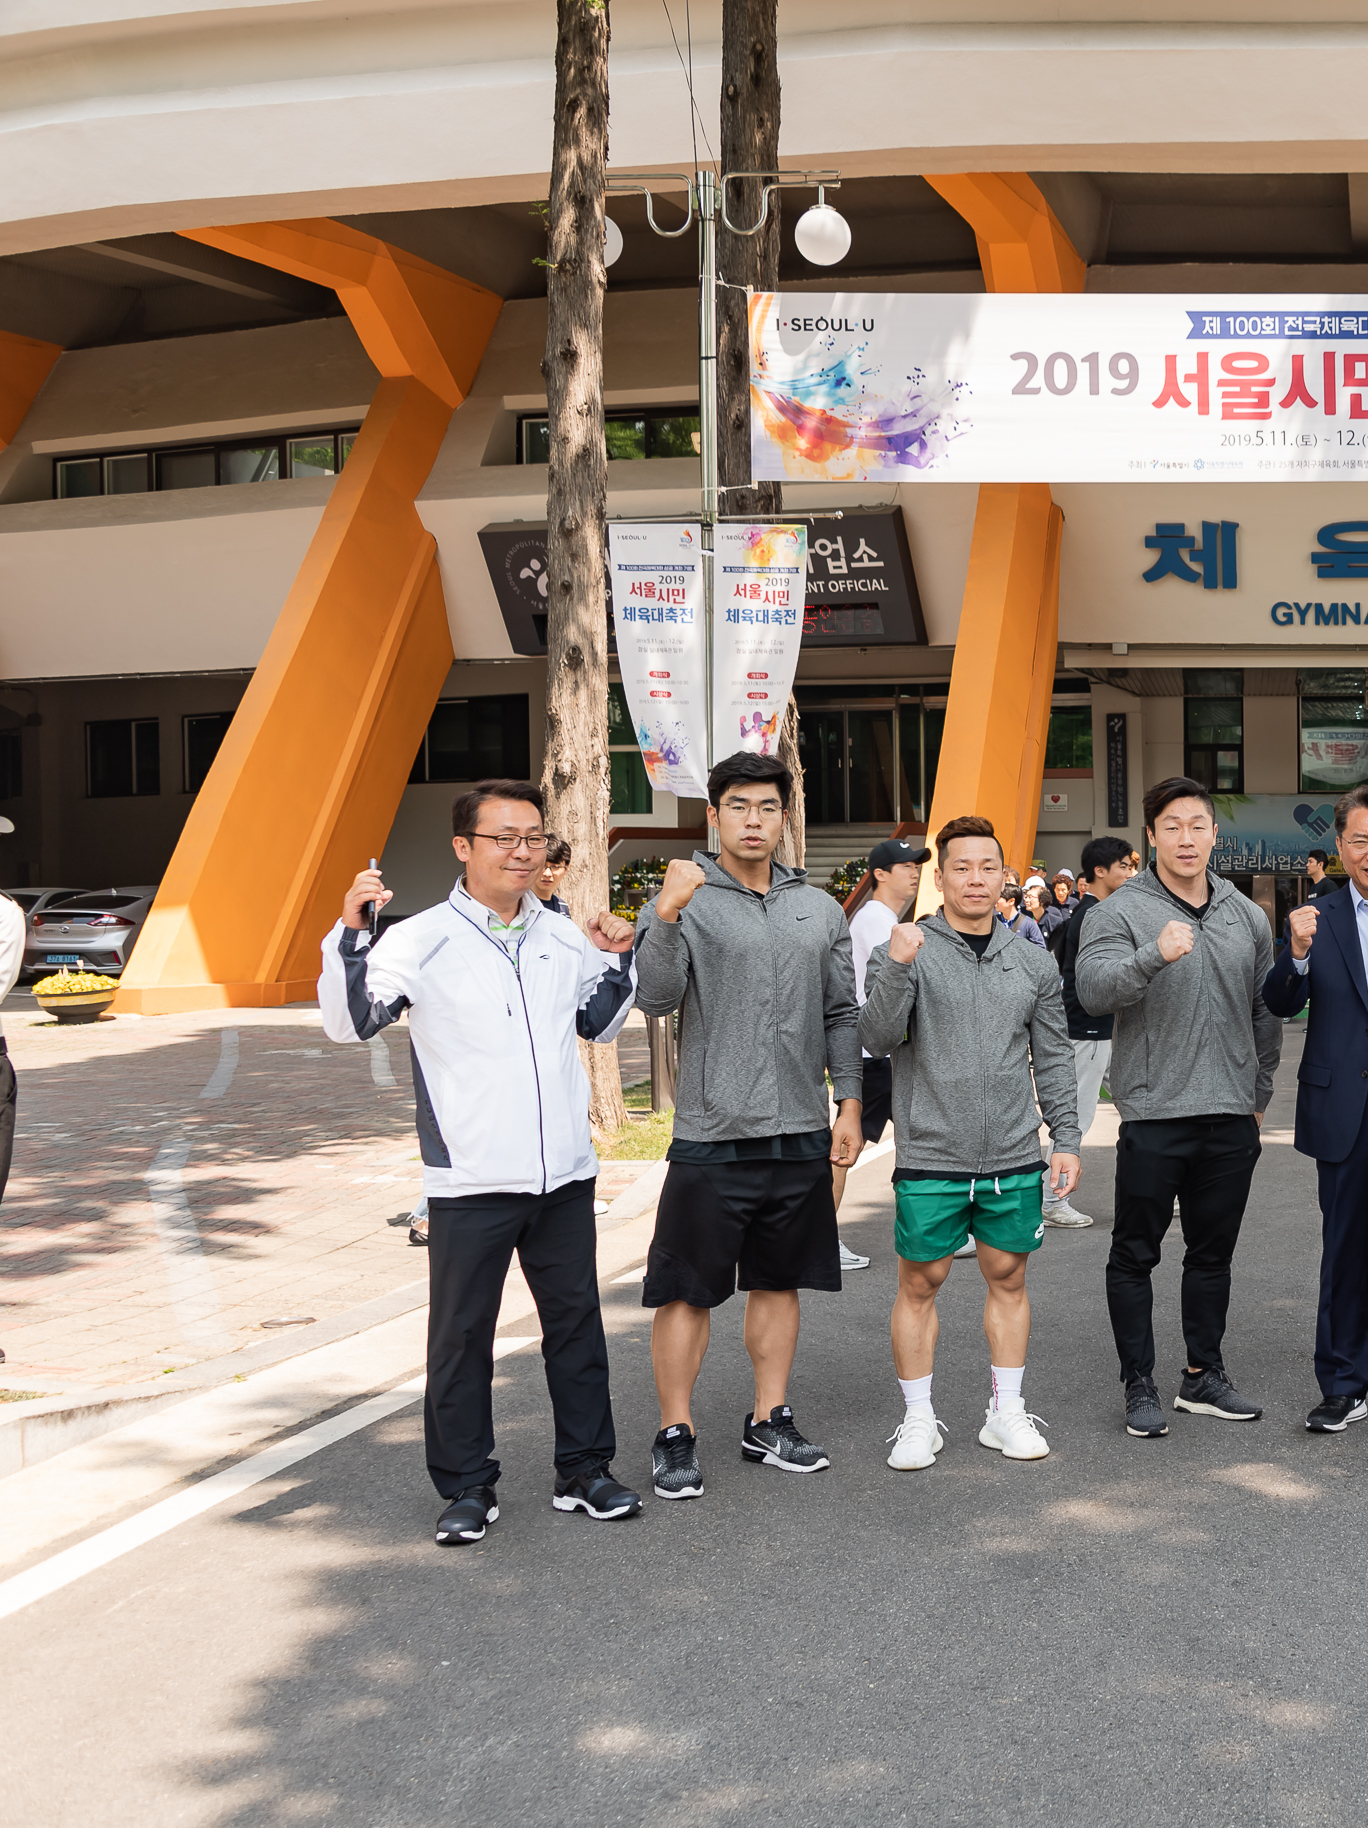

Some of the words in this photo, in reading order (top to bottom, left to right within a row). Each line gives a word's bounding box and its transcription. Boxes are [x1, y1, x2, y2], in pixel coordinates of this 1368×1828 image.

[1202, 316, 1221, 336] 제
[1227, 316, 1280, 336] 100회
[1010, 351, 1139, 396] 2019
[1220, 429, 1318, 447] 2019.5.11.(토)
[1295, 459, 1340, 469] 자치구체육회,
[505, 540, 545, 569] METROPOLITAN
[506, 571, 520, 595] SEOUL
[658, 575, 685, 585] 2019
[765, 578, 790, 587] 2019
[805, 581, 825, 593] NT
[828, 579, 889, 593] OFFICIAL
[622, 606, 694, 624] 체육대축전
[725, 608, 797, 626] 체육대축전
